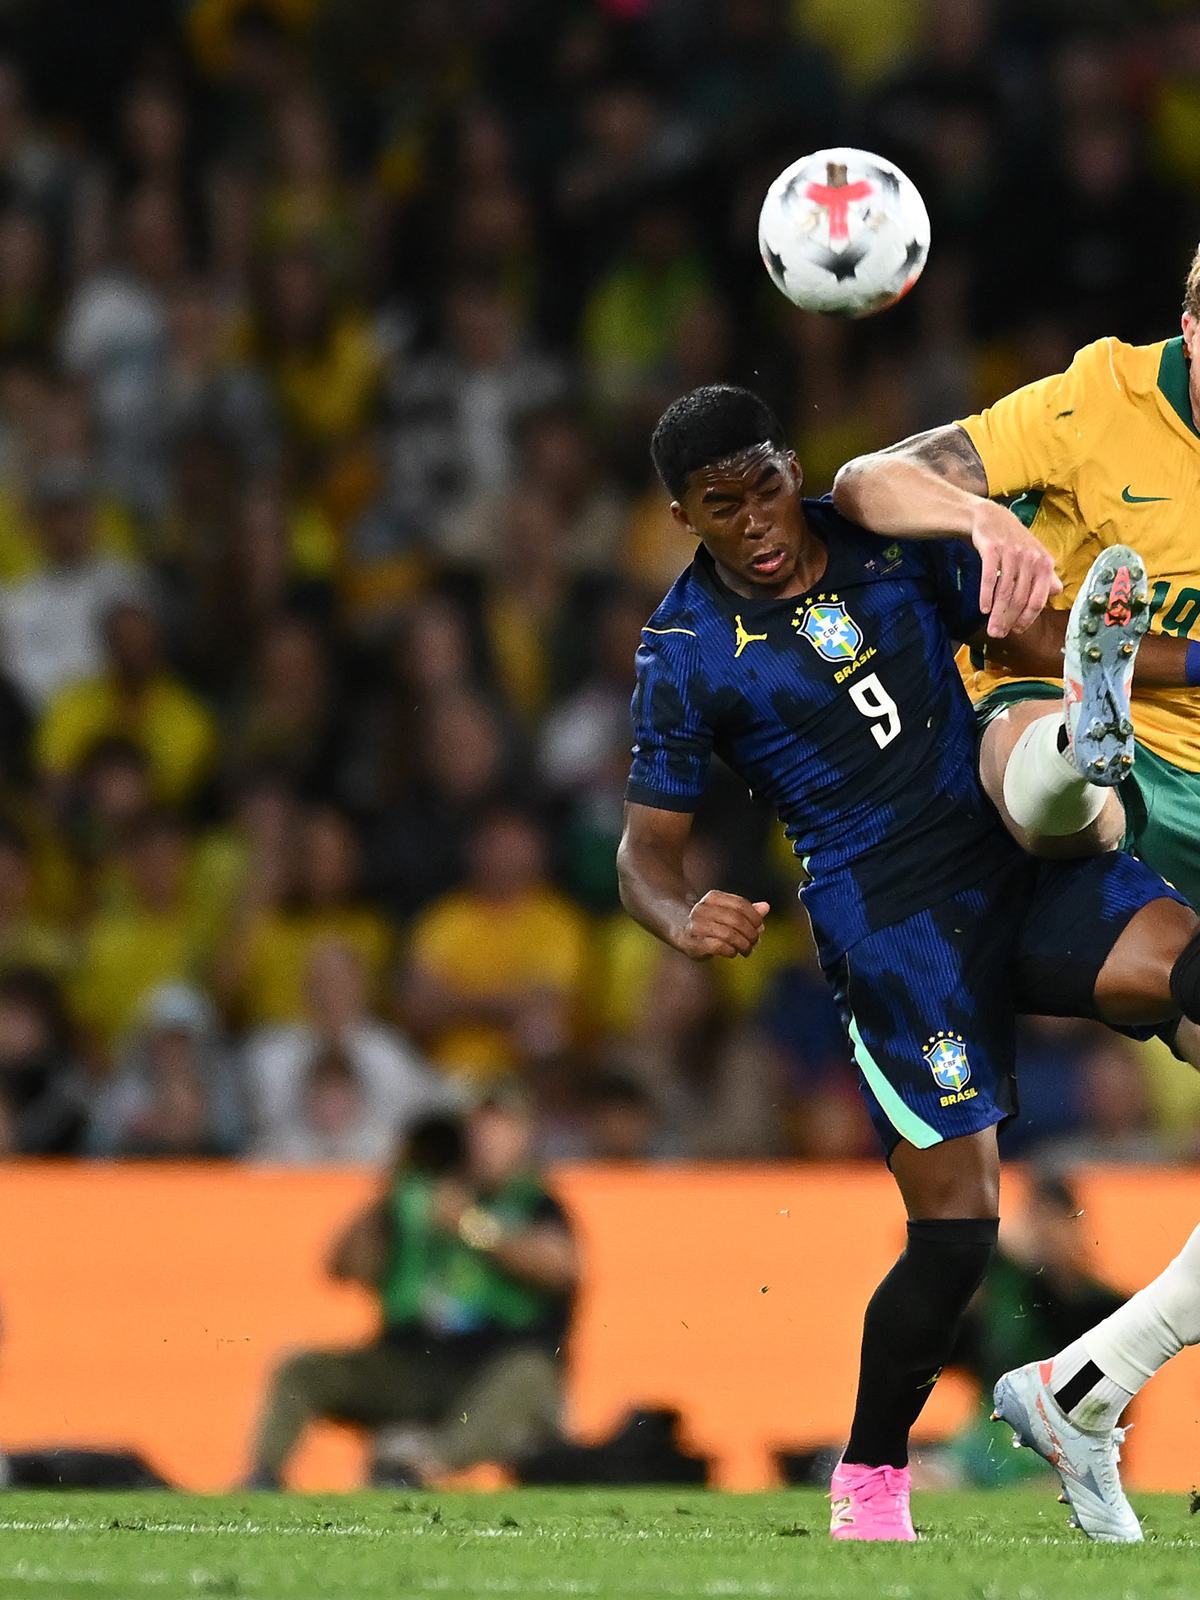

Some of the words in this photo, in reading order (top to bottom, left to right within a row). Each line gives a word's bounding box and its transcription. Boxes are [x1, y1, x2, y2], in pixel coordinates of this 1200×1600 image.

[823, 624, 839, 638] CBF
[833, 646, 877, 685] BRASIL
[848, 672, 902, 750] 9
[943, 1060, 956, 1068] CBF
[940, 1088, 978, 1106] BRASIL
